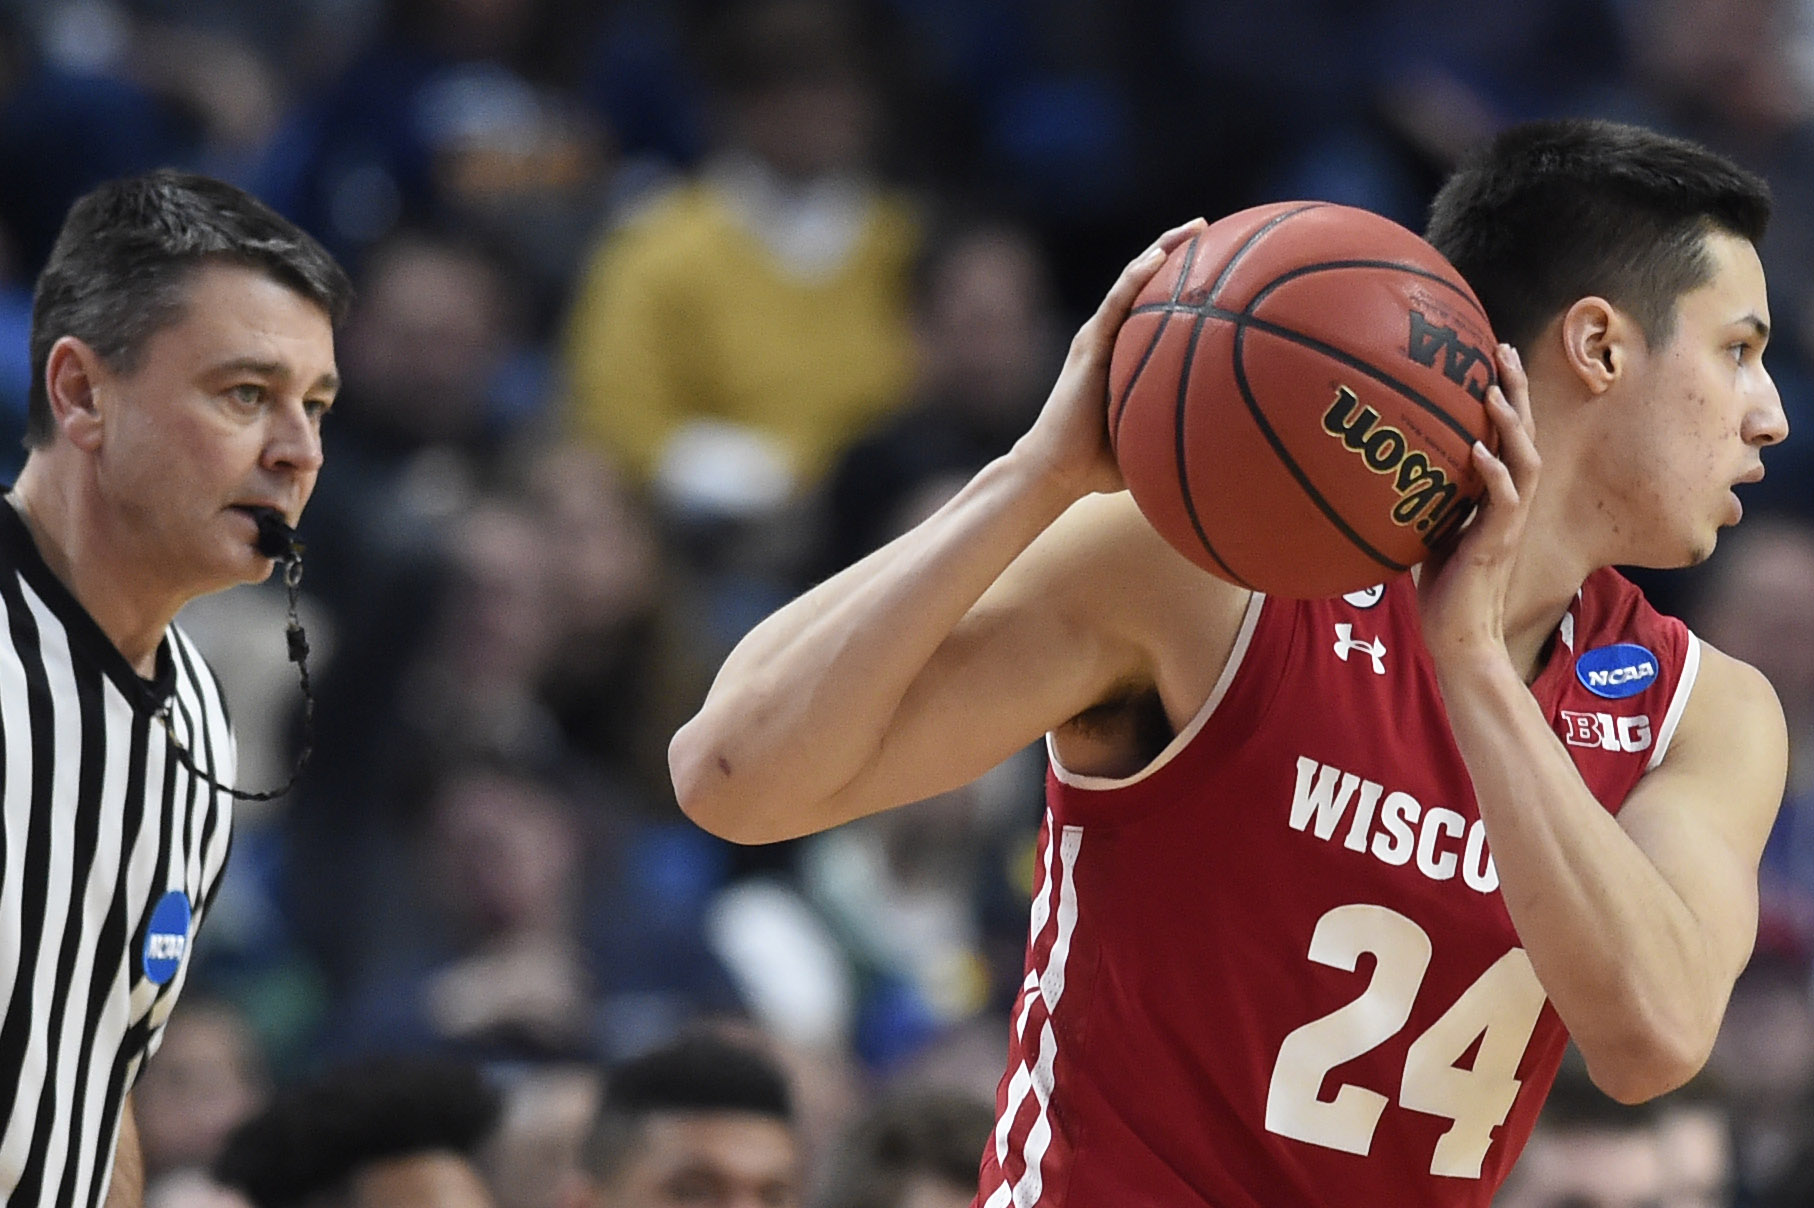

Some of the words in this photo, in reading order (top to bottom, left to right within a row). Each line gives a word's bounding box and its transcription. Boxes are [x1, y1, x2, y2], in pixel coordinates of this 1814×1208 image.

[1408, 309, 1496, 404] CAA
[1588, 661, 1654, 686] NCAA
[1289, 755, 1500, 894] WISCO
[1265, 903, 1548, 1179] 24
